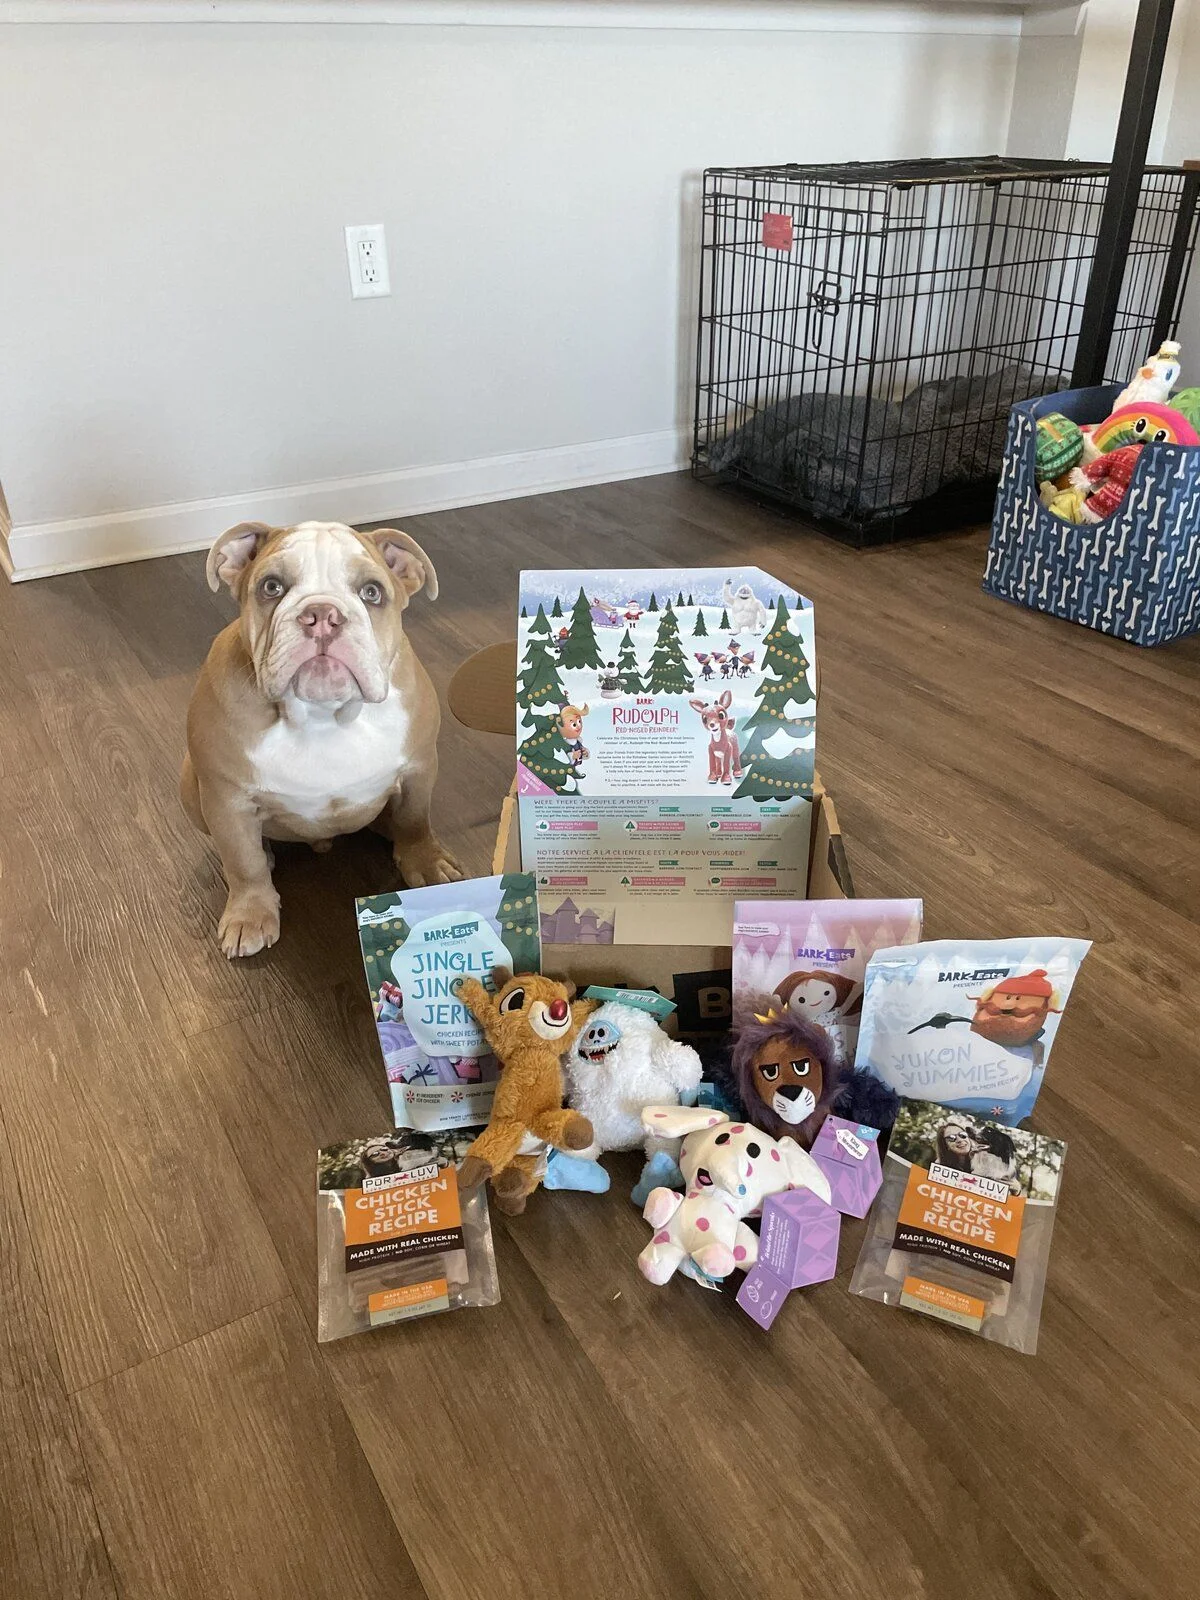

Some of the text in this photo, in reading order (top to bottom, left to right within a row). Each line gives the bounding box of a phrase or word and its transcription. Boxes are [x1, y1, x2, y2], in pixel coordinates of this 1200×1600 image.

[612, 707, 679, 725] RUDOLPH
[424, 926, 476, 941] BARK Eats
[440, 939, 467, 947] PRESENTS
[411, 951, 494, 974] JINGLE
[797, 948, 826, 959] BARK
[812, 961, 839, 969] PRESENTS
[411, 974, 496, 999] JINGE
[938, 972, 972, 982] BARK
[421, 1004, 476, 1025] JERK
[437, 1030, 463, 1038] CHICKEN
[891, 1042, 971, 1070] YUKON
[900, 1060, 1009, 1087] YUMMIES
[410, 1166, 435, 1178] LUV
[355, 1179, 448, 1210] CHICKEN
[979, 1179, 1005, 1194] LUV
[374, 1195, 432, 1221] STICK
[916, 1184, 1012, 1222] CHICKEN
[931, 1201, 992, 1229] STICK
[368, 1209, 439, 1237] RECIPE
[923, 1211, 996, 1244] RECIPE
[350, 1234, 459, 1260] MADE WITH REAL CHICKEN
[899, 1233, 1010, 1271] MADE WITH REAL CHICKEN
